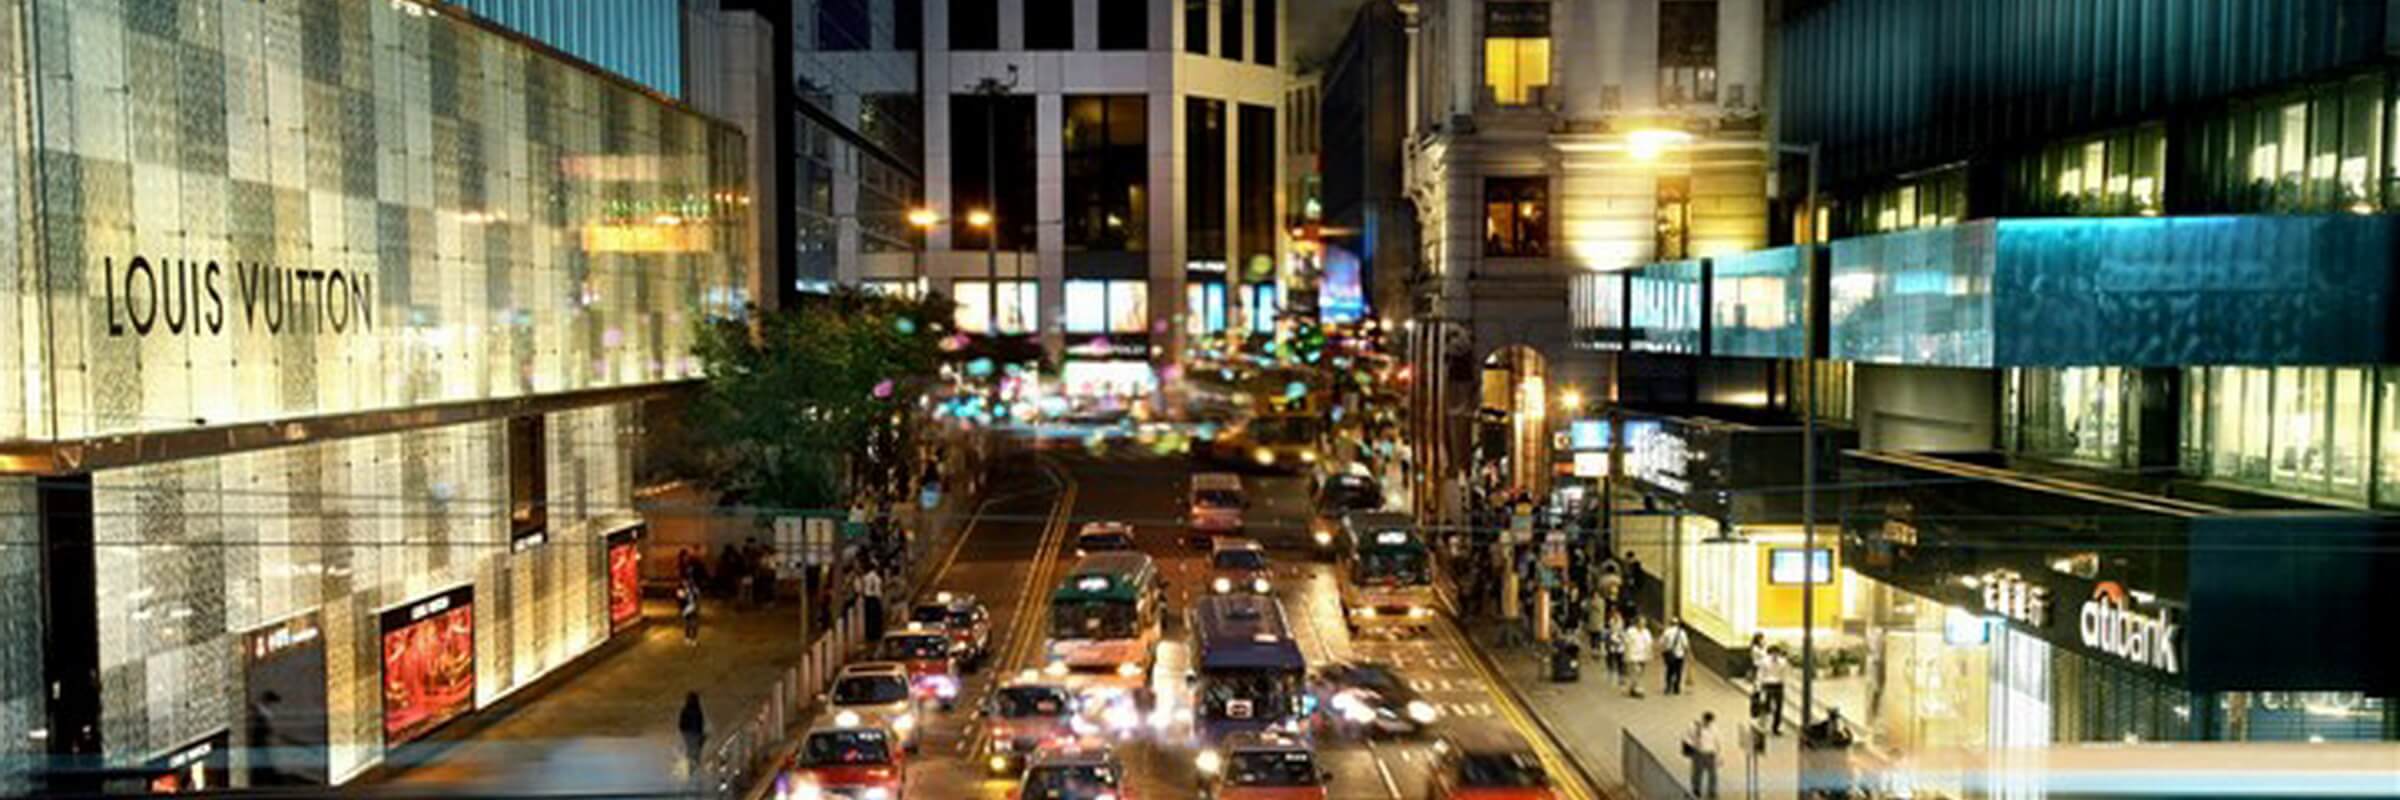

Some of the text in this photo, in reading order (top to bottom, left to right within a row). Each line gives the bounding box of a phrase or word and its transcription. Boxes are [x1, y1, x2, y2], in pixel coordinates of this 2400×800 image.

[105, 256, 372, 336] LOUIS VUITTON
[2081, 596, 2178, 673] citibank
